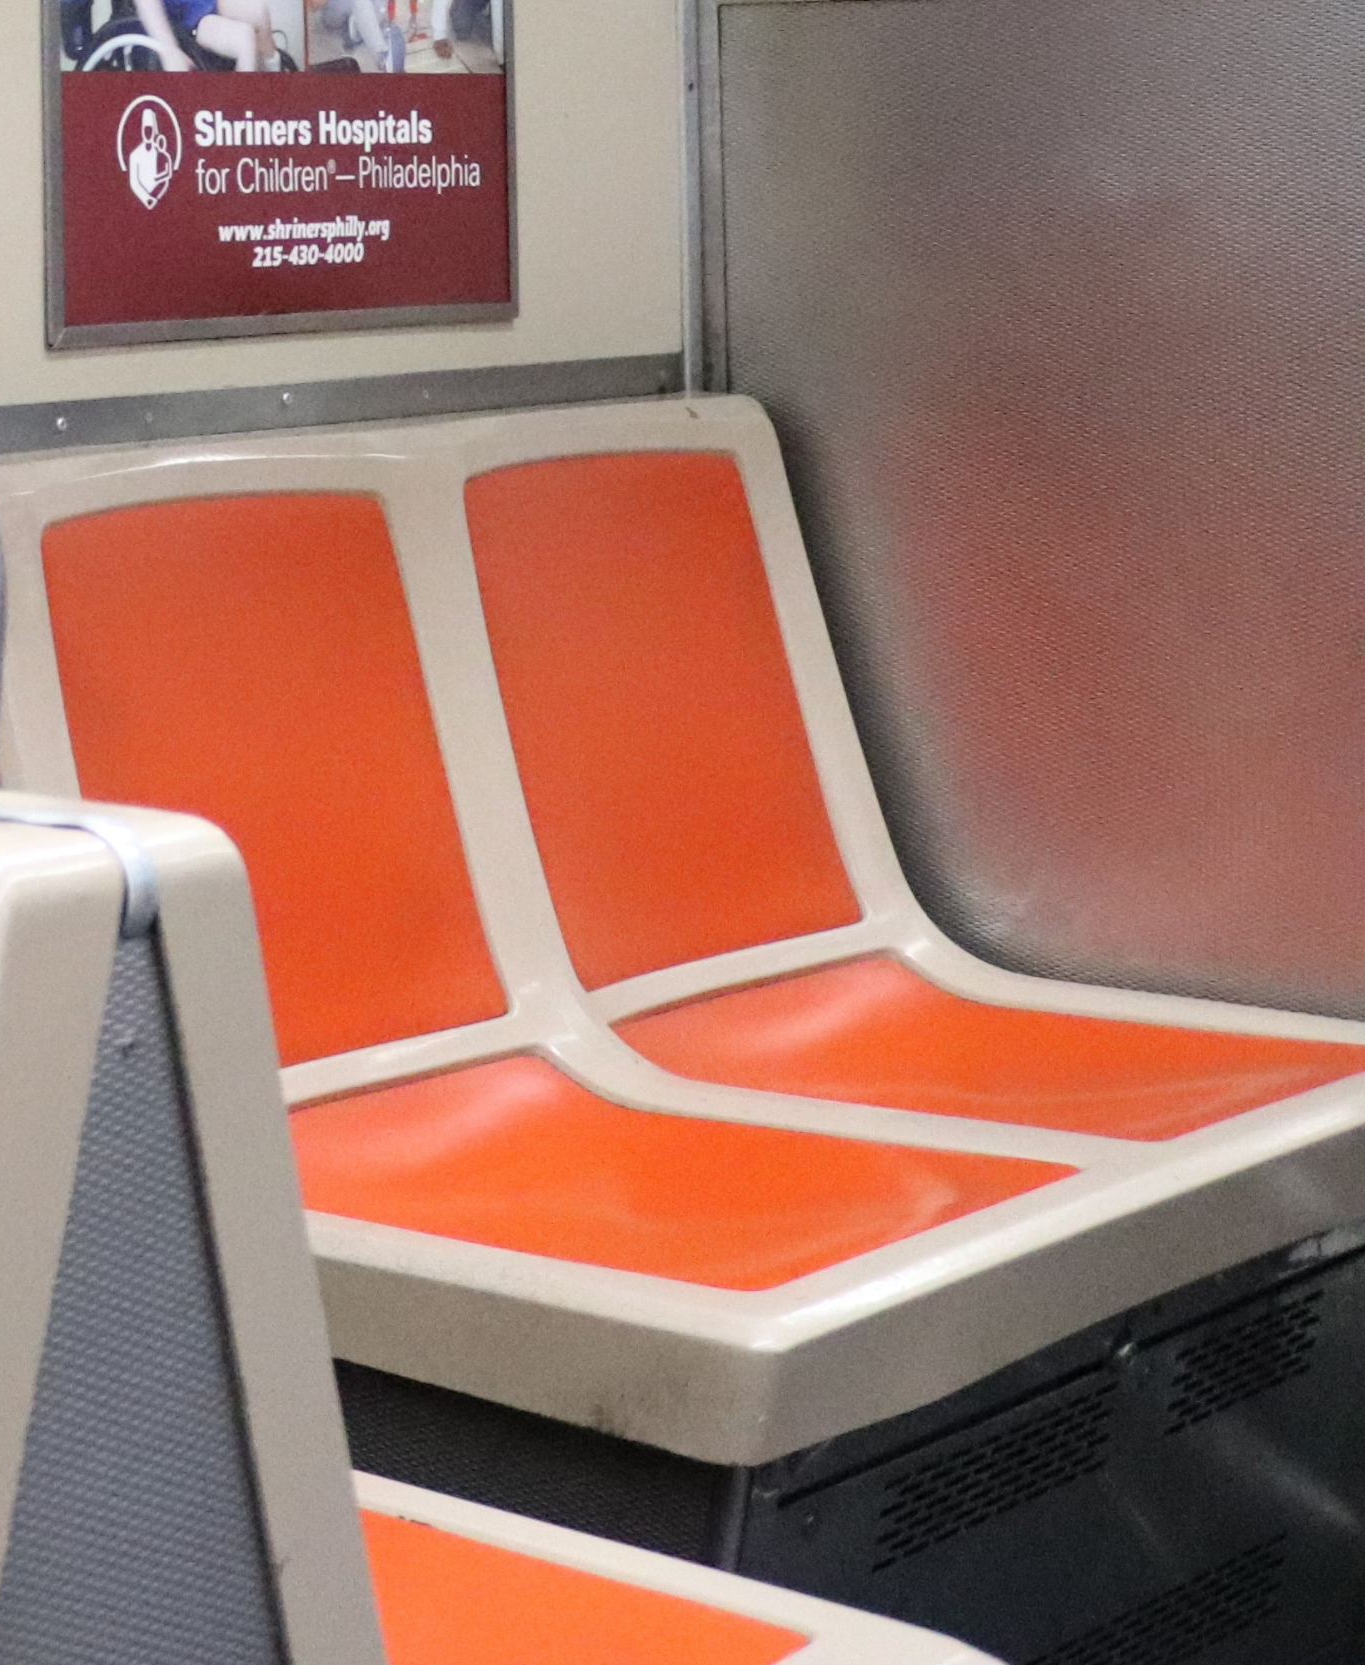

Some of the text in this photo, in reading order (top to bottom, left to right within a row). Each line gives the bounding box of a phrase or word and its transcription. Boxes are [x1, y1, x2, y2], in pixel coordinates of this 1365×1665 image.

[194, 109, 433, 153] Shriners Hospitals
[195, 158, 231, 195] for
[218, 215, 391, 244] www.shrinersphilly.org
[251, 242, 365, 268] 215-430-4000
